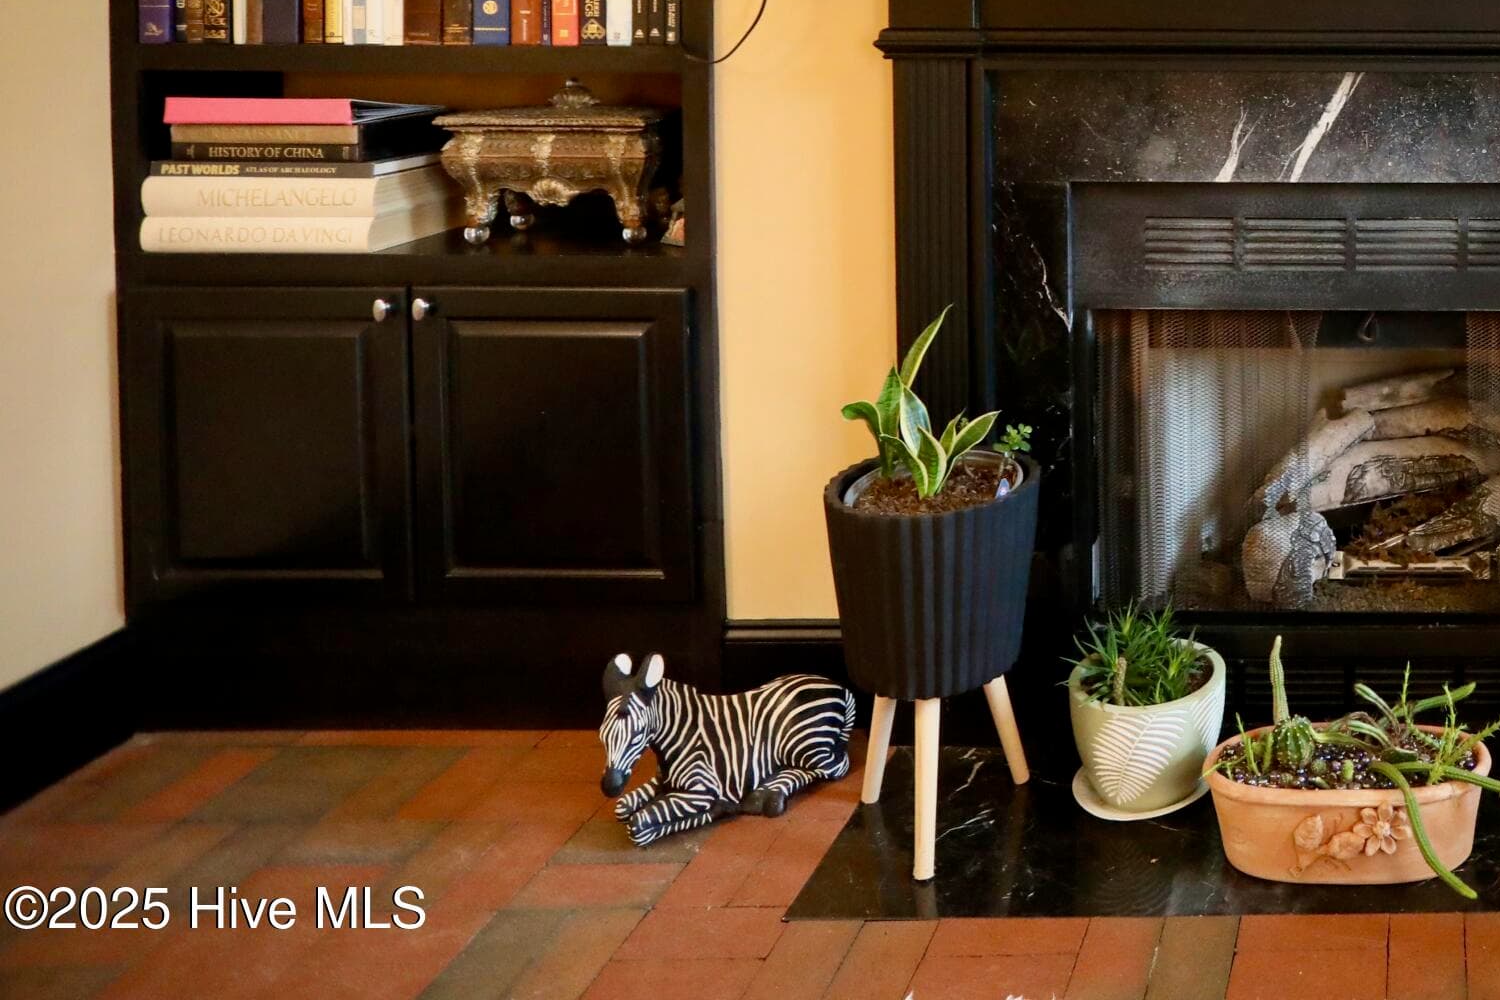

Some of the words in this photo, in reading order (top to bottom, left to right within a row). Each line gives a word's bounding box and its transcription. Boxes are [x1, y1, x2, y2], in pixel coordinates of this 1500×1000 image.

[208, 146, 261, 158] HISTORY
[264, 148, 281, 159] OF
[283, 148, 324, 159] CHINA
[160, 163, 189, 175] PAST
[190, 164, 240, 175] WORLDS
[280, 167, 337, 175] ARCHAEOLOGY
[198, 187, 358, 208] MICHELANGELO
[158, 226, 266, 244] LEONARDO
[271, 227, 298, 244] DA
[300, 227, 354, 244] VINCI
